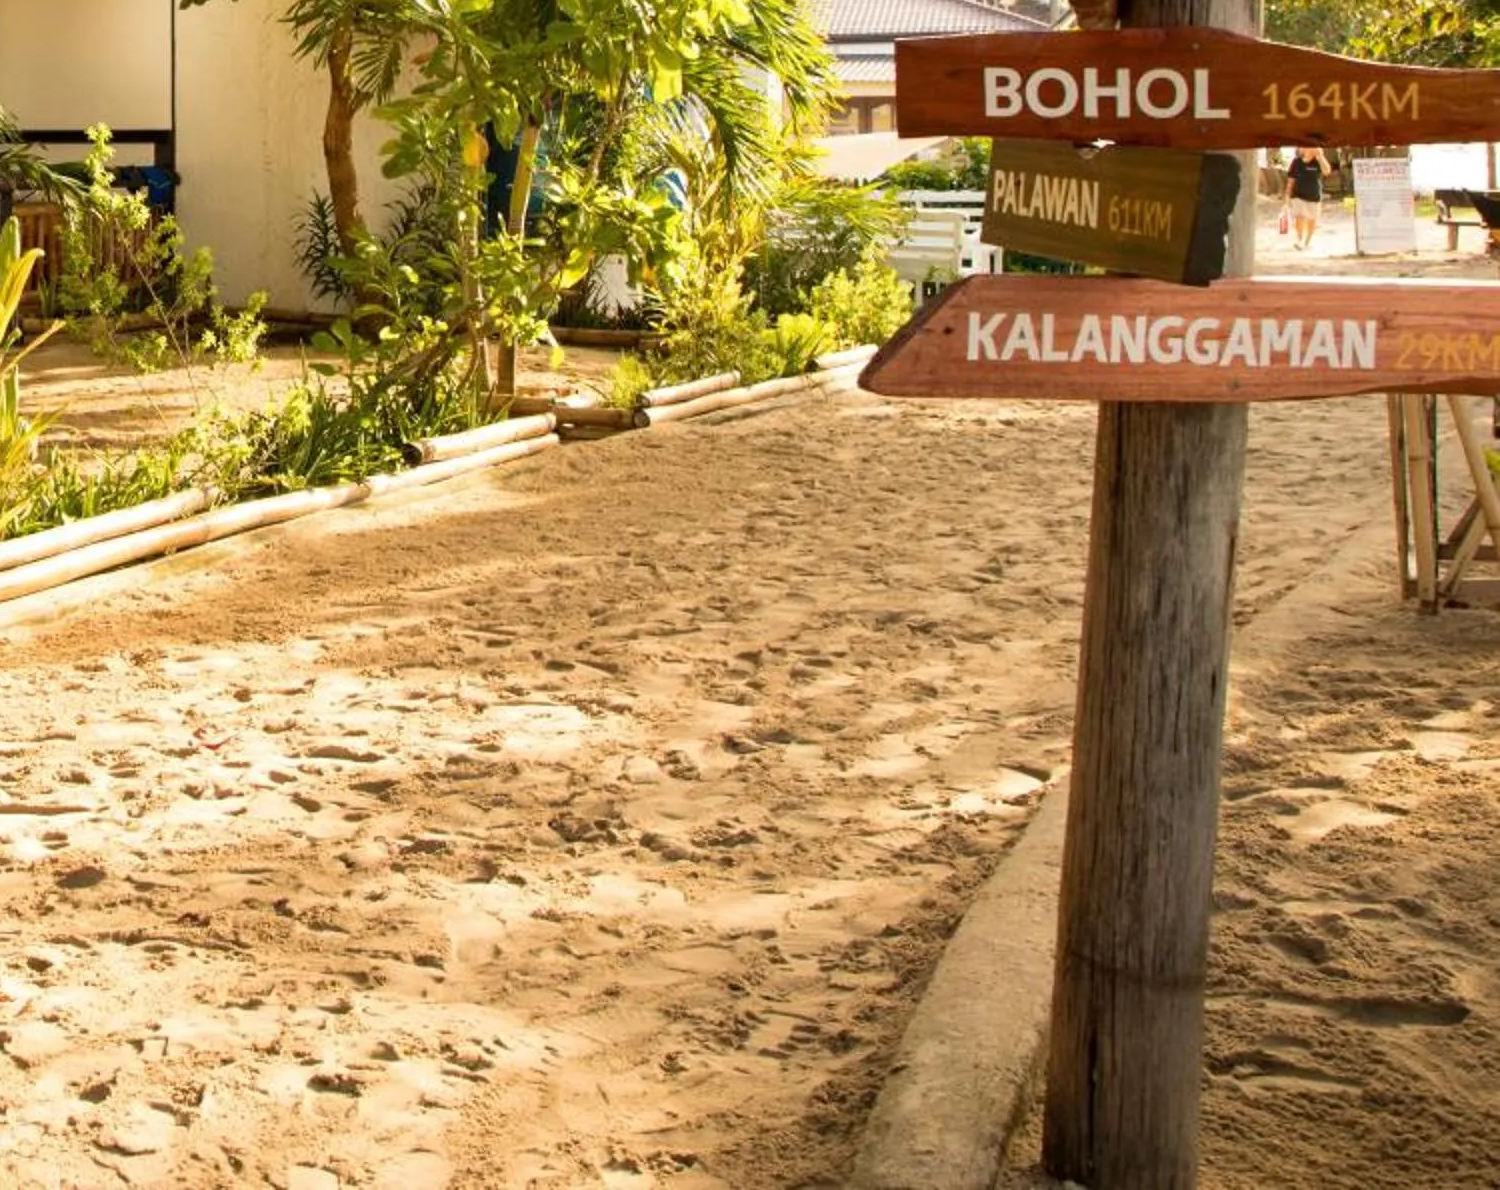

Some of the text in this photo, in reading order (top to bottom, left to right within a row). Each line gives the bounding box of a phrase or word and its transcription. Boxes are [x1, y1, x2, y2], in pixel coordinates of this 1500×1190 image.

[983, 66, 1421, 122] BOHOL 164KM
[993, 170, 1099, 229] PALAWAN
[966, 311, 1500, 371] KALANGGAMAN 29KM
